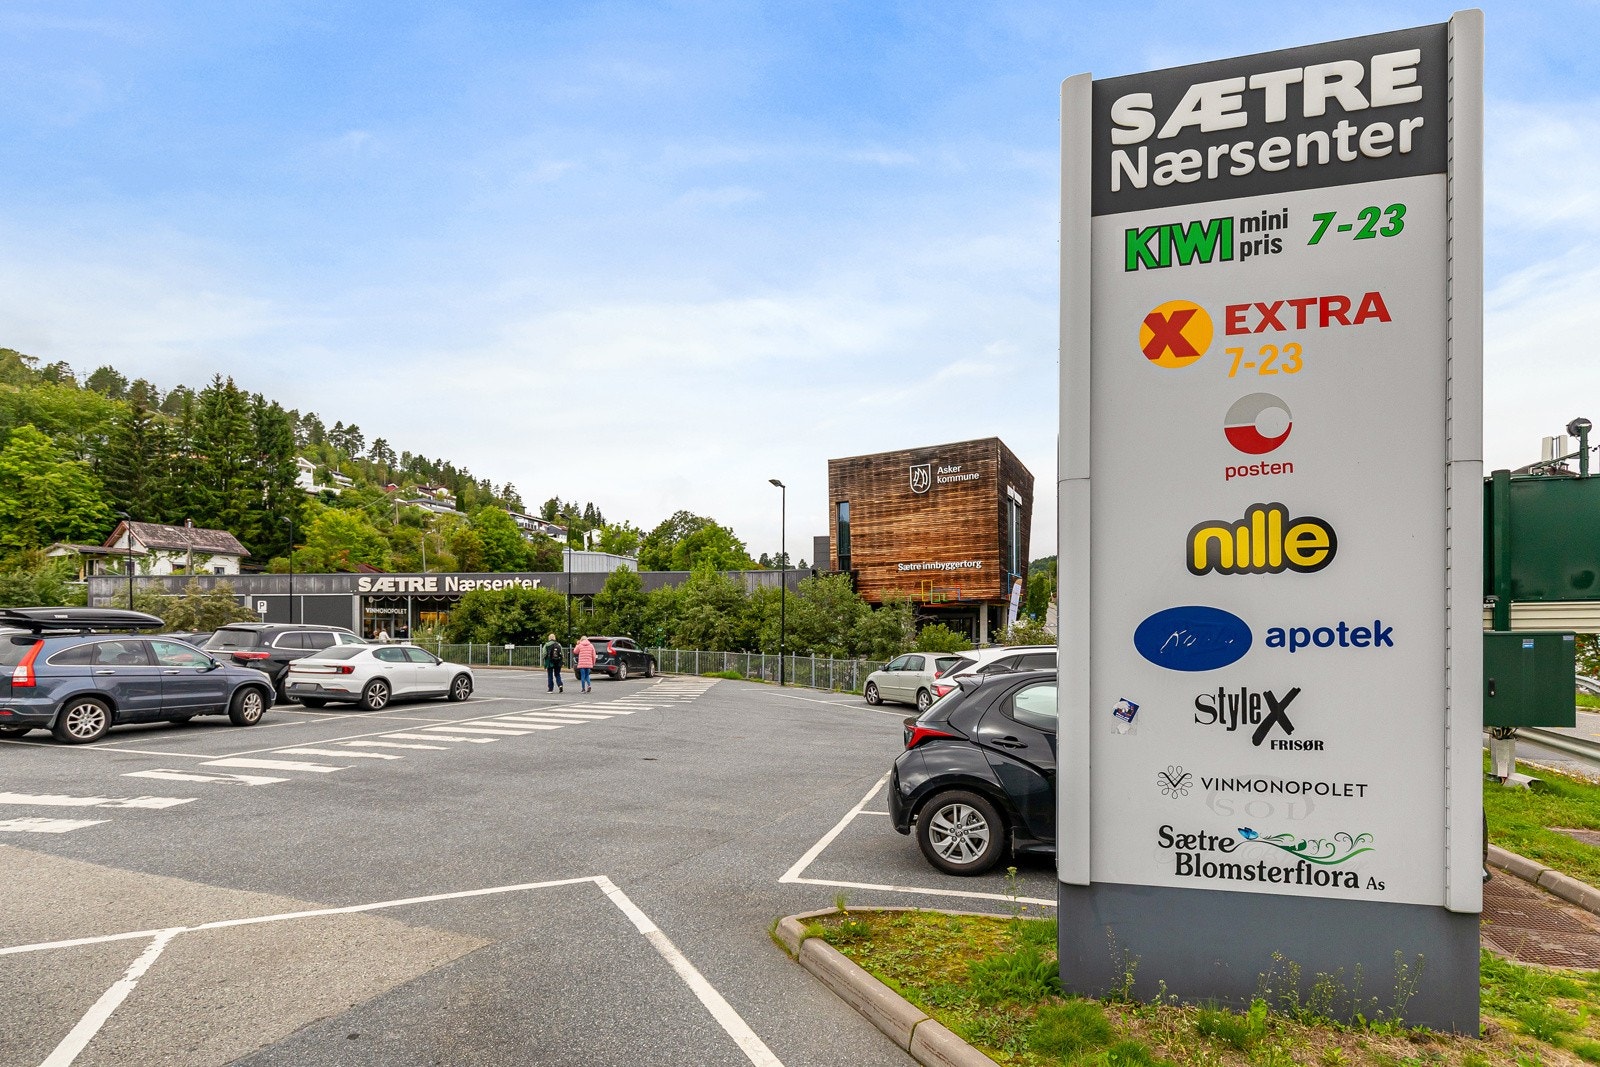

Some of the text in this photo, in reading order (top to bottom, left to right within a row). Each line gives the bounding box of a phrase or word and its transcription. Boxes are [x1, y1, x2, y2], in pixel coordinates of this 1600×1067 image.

[1110, 48, 1423, 145] SÆTRE
[1110, 116, 1424, 193] Nærsenter
[1239, 207, 1288, 234] mini
[1307, 203, 1407, 246] 7-23
[1125, 216, 1235, 273] KIWI
[1239, 234, 1283, 262] pris
[1225, 291, 1392, 336] EXTRA
[1225, 342, 1304, 378] 7-23
[937, 465, 962, 475] Asker
[937, 472, 980, 484] kommune
[1225, 461, 1294, 481] posten
[1193, 509, 1330, 570] nille
[898, 560, 982, 571] Sætre innbyggertorg
[358, 576, 541, 592] SÆTRE Nærsenter
[365, 607, 408, 615] VINMONOPOLET
[1266, 619, 1394, 653] apotek
[1270, 739, 1325, 751] FRISØR
[1201, 777, 1368, 798] VINMONOPOLET
[1158, 825, 1235, 853] Sætre
[1174, 852, 1360, 889] Blomsterflora
[1366, 876, 1386, 891] As
